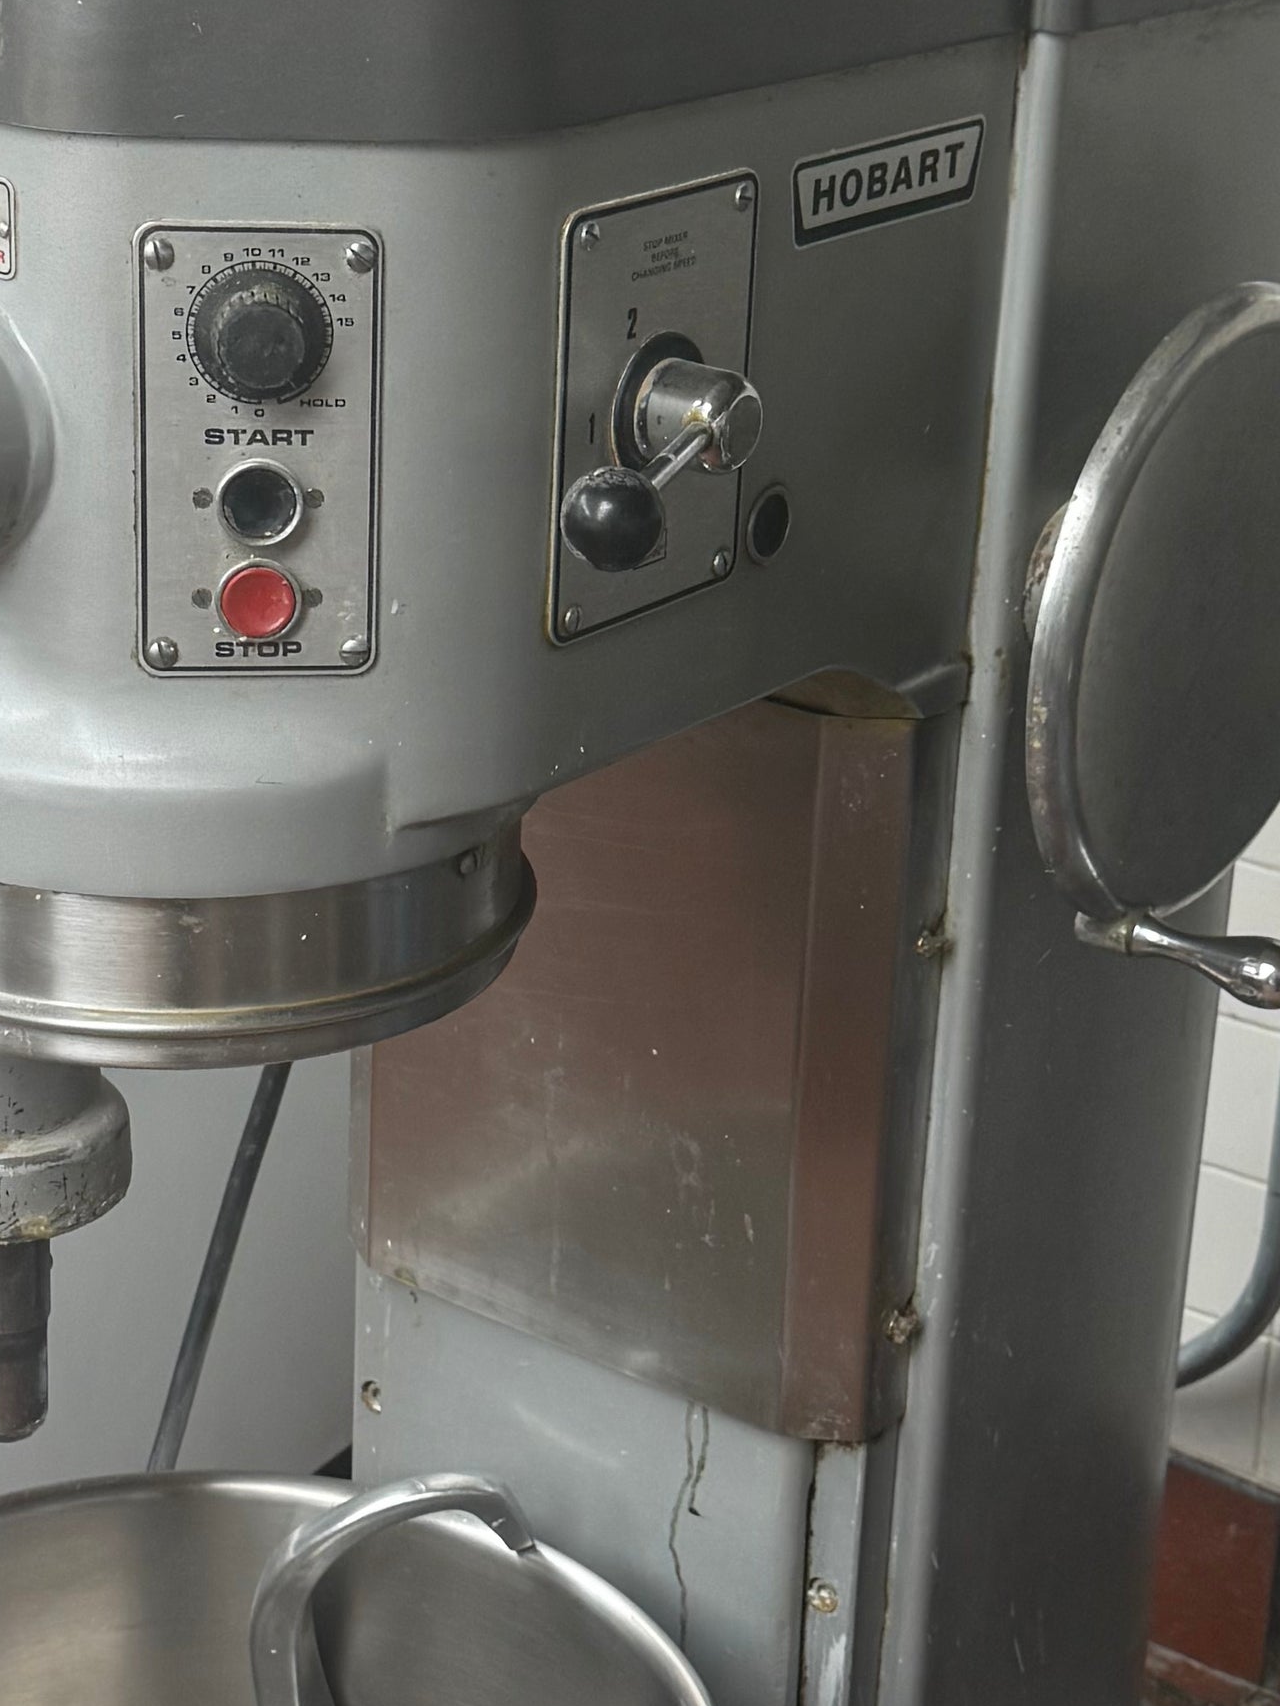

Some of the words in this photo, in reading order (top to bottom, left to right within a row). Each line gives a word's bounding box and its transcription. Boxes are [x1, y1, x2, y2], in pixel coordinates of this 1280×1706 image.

[812, 141, 965, 216] HOBART
[223, 252, 234, 262] 9
[243, 247, 262, 258] 10
[268, 248, 285, 258] 11
[292, 257, 311, 266] 12
[201, 265, 211, 275] 8
[312, 273, 331, 282] 13
[186, 286, 196, 295] 7
[329, 294, 347, 303] 14
[174, 307, 185, 316] 6
[336, 318, 354, 327] 15
[627, 307, 637, 340] 2
[171, 331, 182, 340] 5
[176, 354, 187, 363] 4
[189, 377, 200, 386] 3
[206, 394, 217, 404] 2
[300, 398, 346, 408] HOLD
[231, 406, 239, 415] 1
[253, 408, 265, 417] 0
[588, 413, 595, 445] 1
[204, 428, 315, 446] START
[215, 641, 302, 658] STOP
